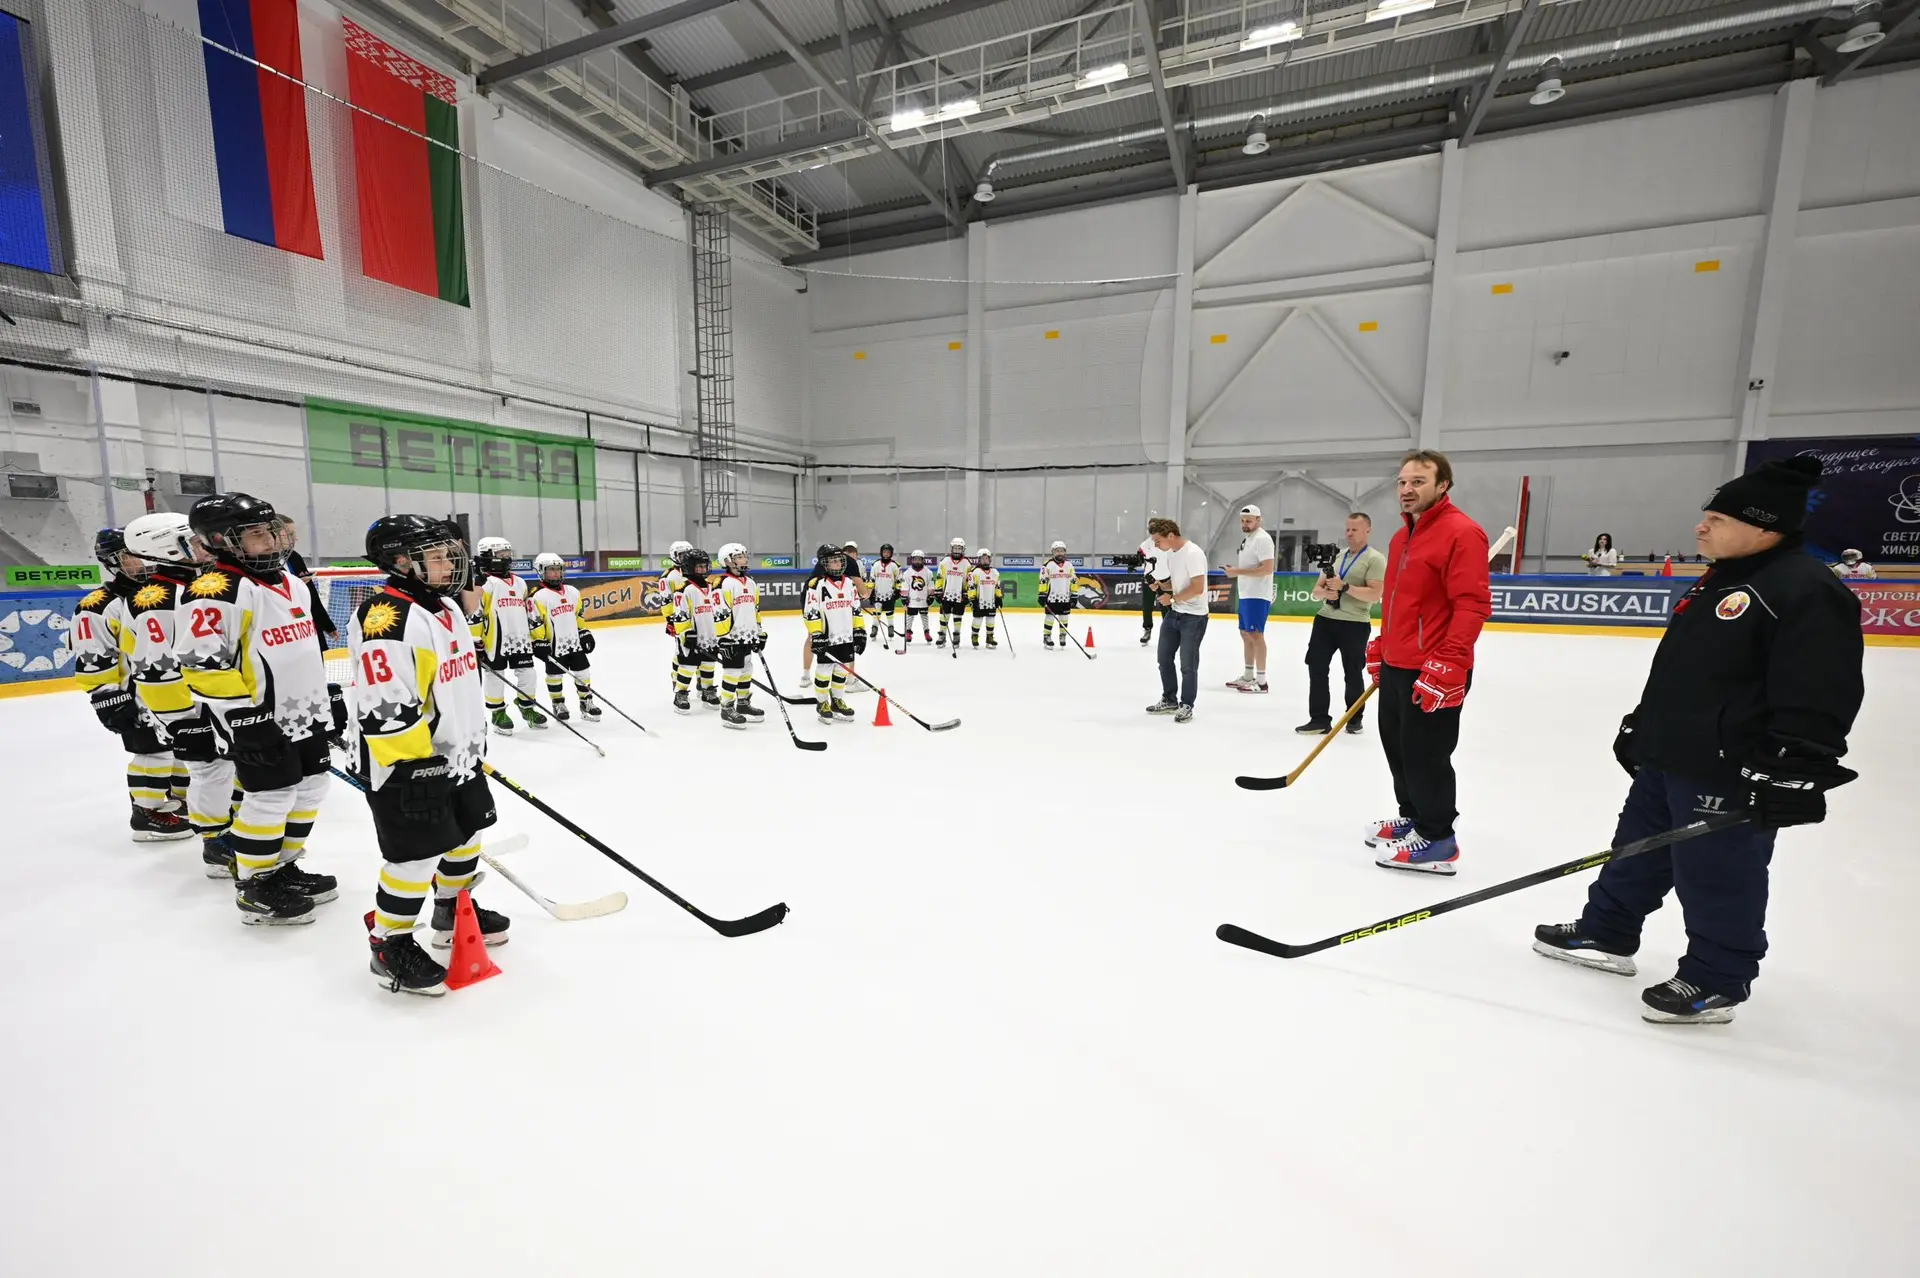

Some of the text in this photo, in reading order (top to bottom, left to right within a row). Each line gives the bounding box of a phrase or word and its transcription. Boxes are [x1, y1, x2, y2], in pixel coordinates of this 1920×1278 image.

[1880, 545, 1920, 555] ХИМВ
[757, 581, 804, 597] ELTEL
[1114, 582, 1143, 595] СТРЕ
[1490, 592, 1670, 614] ELARUSKALI
[146, 617, 166, 644] 9
[191, 607, 224, 639] 22
[361, 648, 394, 686] 13
[1339, 909, 1433, 945] FISCHER
